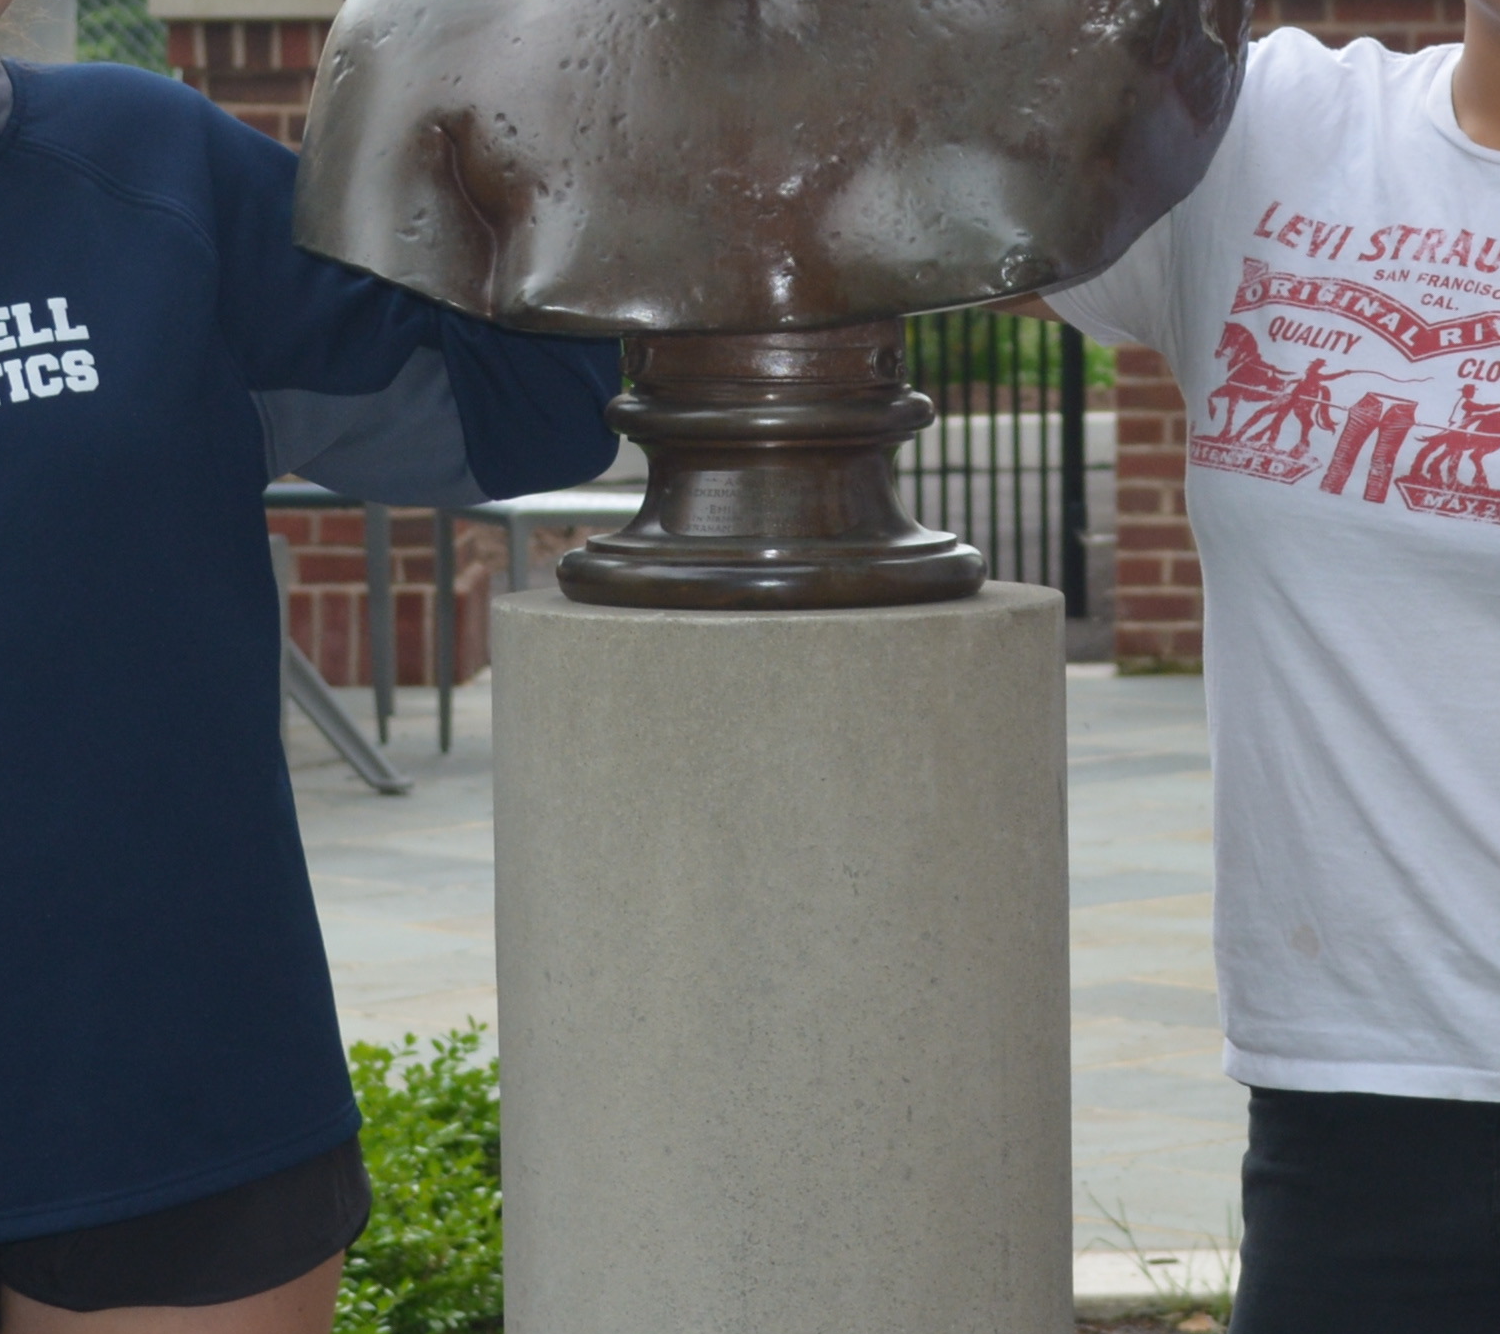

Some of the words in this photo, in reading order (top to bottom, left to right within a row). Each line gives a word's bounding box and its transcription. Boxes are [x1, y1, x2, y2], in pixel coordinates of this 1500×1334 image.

[1252, 201, 1355, 261] LEVI
[1373, 268, 1411, 283] SAN
[1244, 278, 1422, 348] ORIGINAL
[1420, 292, 1460, 311] CAL.
[1267, 314, 1363, 356] QUALITY
[1423, 492, 1479, 514] MAY
